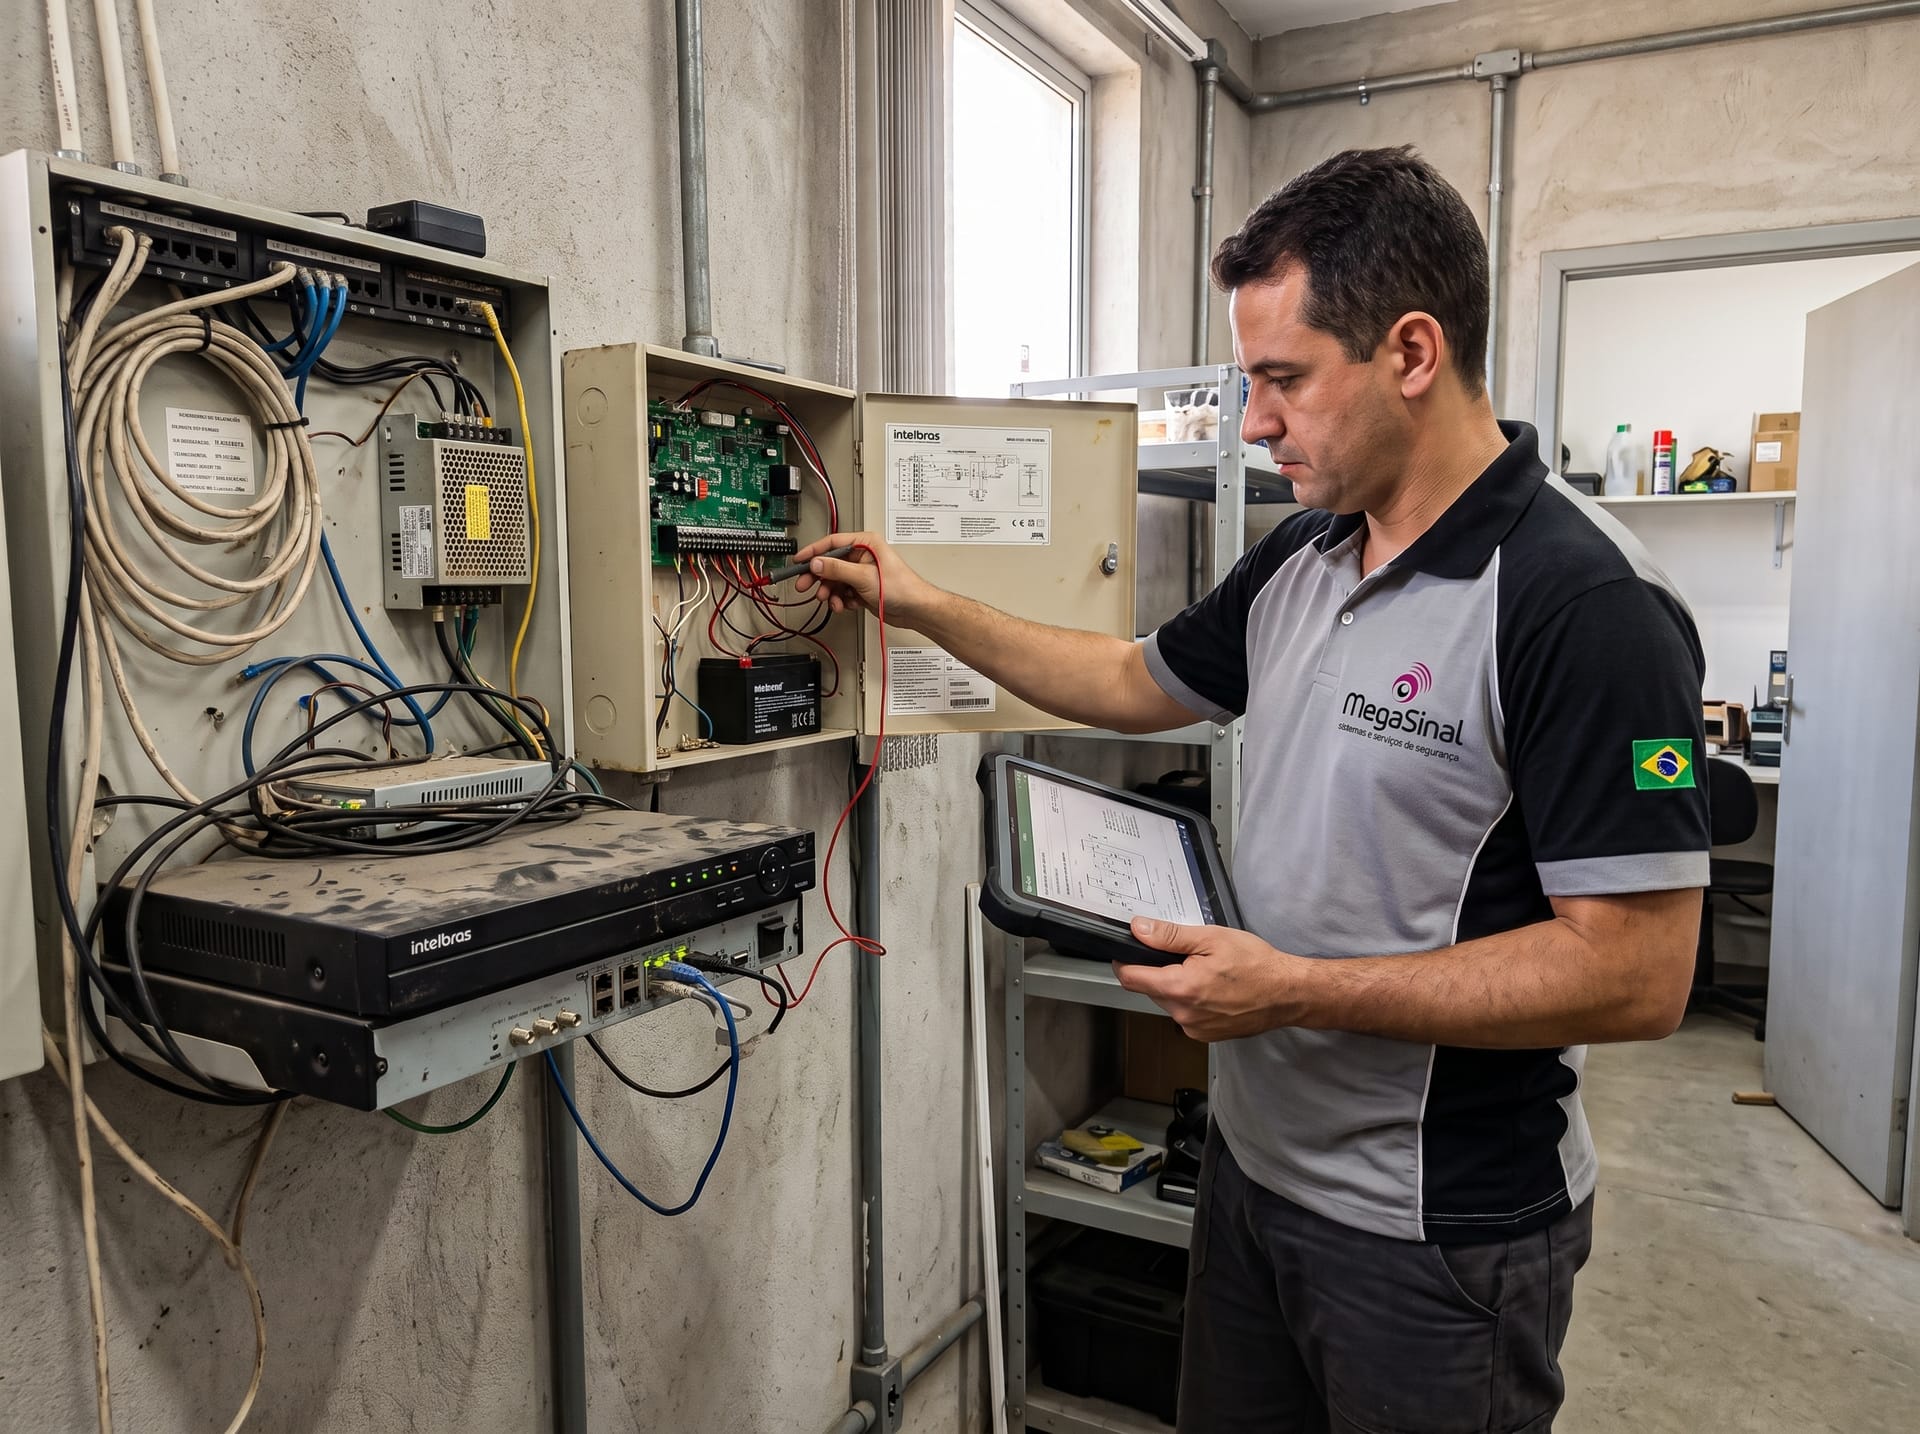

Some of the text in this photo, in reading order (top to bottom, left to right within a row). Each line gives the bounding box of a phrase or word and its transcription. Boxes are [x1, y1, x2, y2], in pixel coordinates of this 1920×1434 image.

[893, 429, 941, 441] intelbras
[1342, 692, 1464, 746] MegaSinal
[1338, 722, 1367, 737] sistemas
[1373, 732, 1403, 747] serviços
[1404, 741, 1414, 750] de
[1415, 744, 1460, 762] segurança
[411, 929, 472, 956] intelbras
